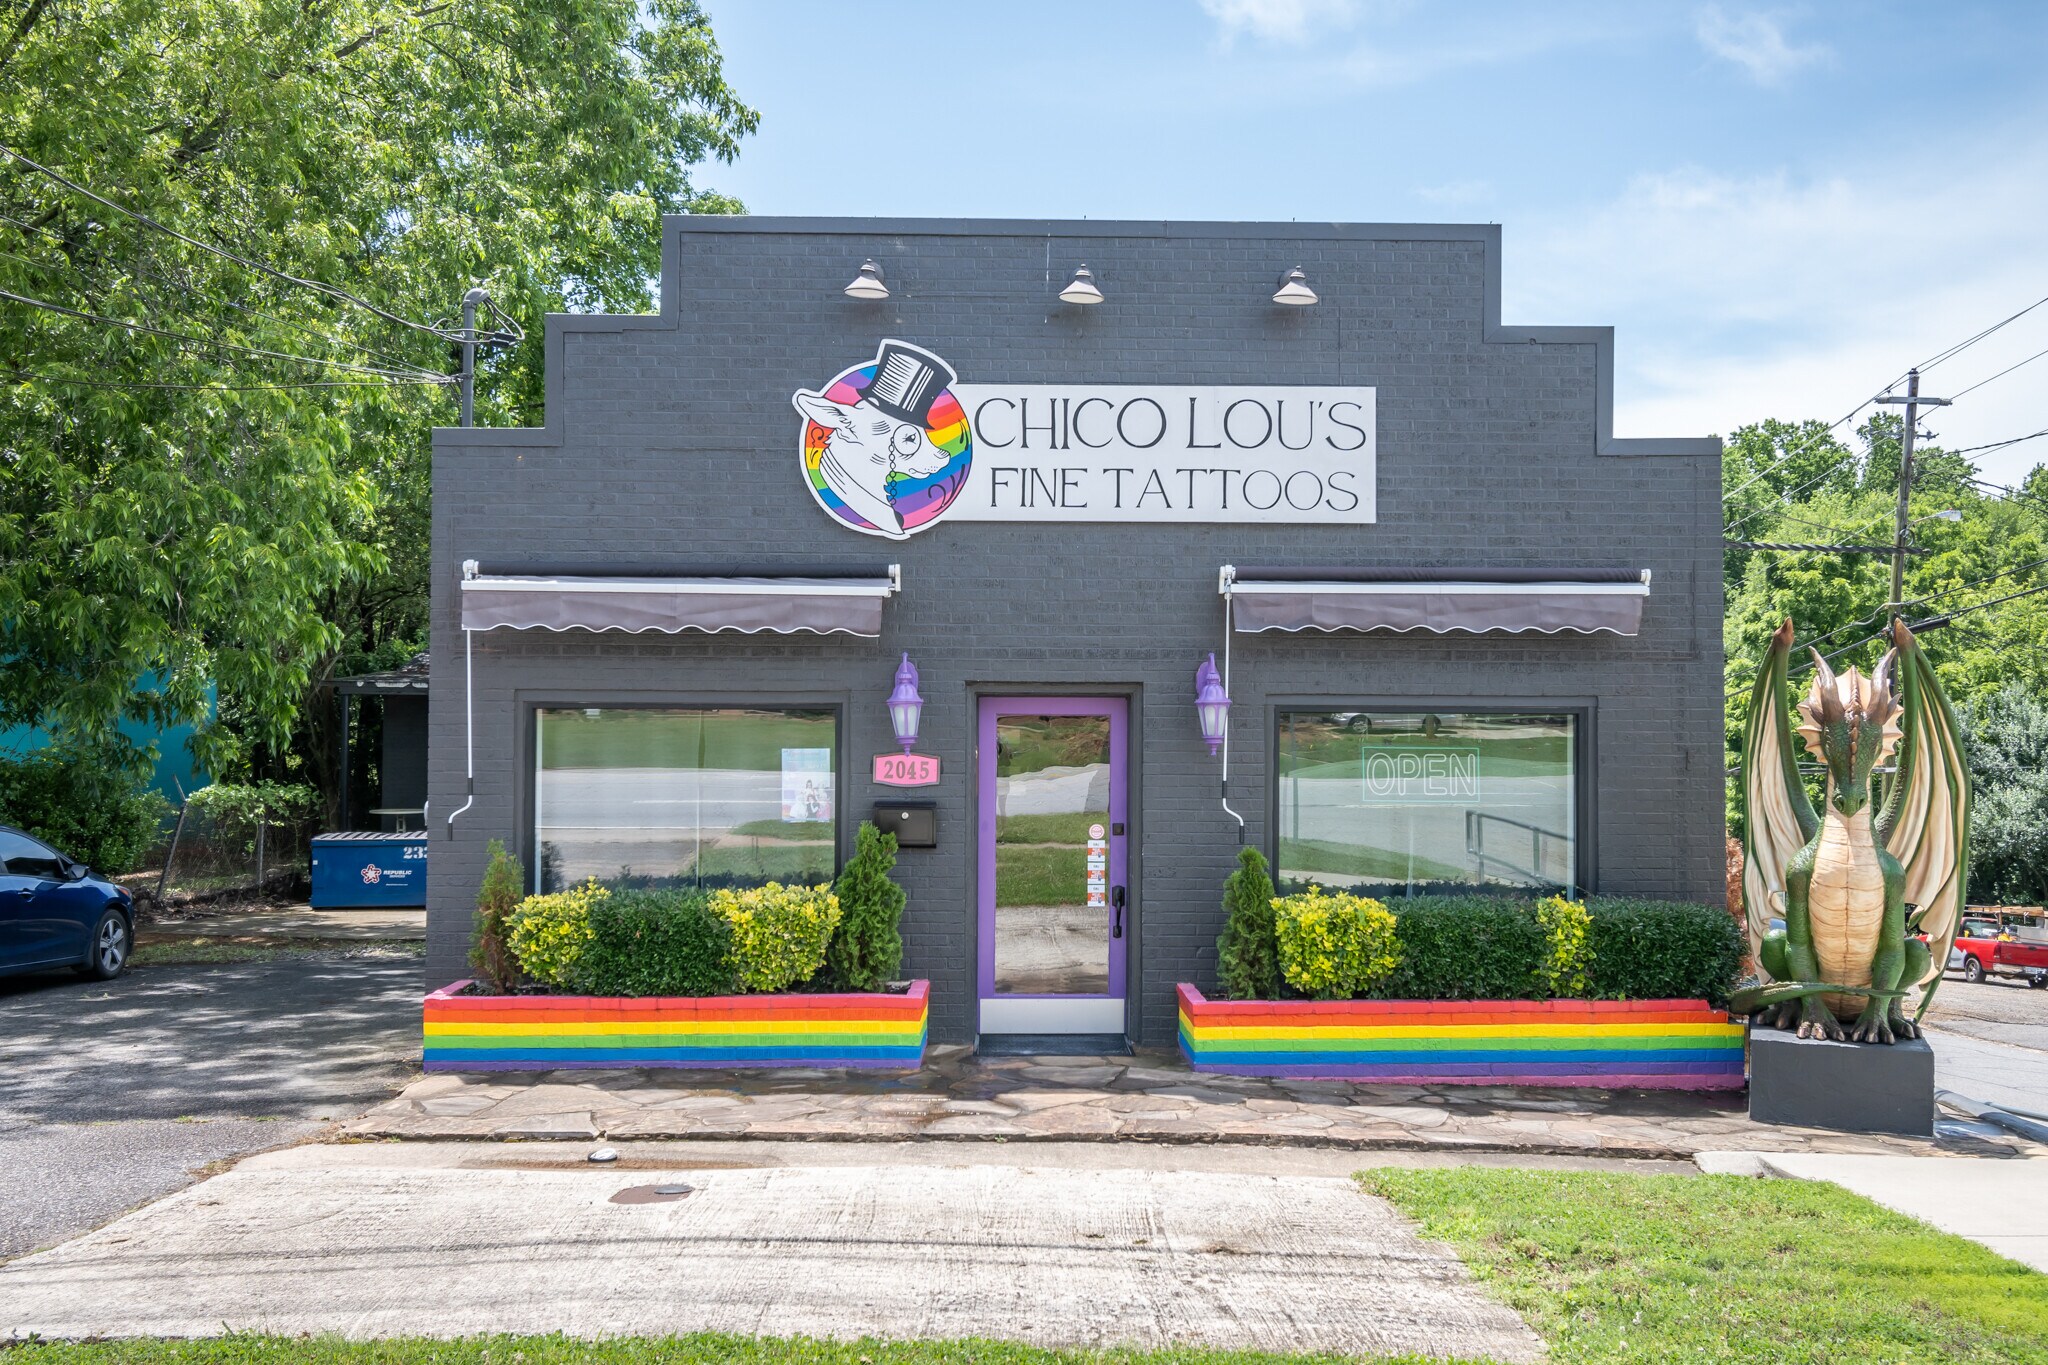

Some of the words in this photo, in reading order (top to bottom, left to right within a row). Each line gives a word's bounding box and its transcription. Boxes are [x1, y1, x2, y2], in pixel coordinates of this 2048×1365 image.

[974, 398, 1167, 449] CHICO
[1186, 397, 1366, 451] LOU'S
[990, 467, 1088, 508] FINE
[1102, 468, 1359, 512] TATTOOS
[884, 761, 930, 780] 2045
[1366, 752, 1476, 796] OPEN
